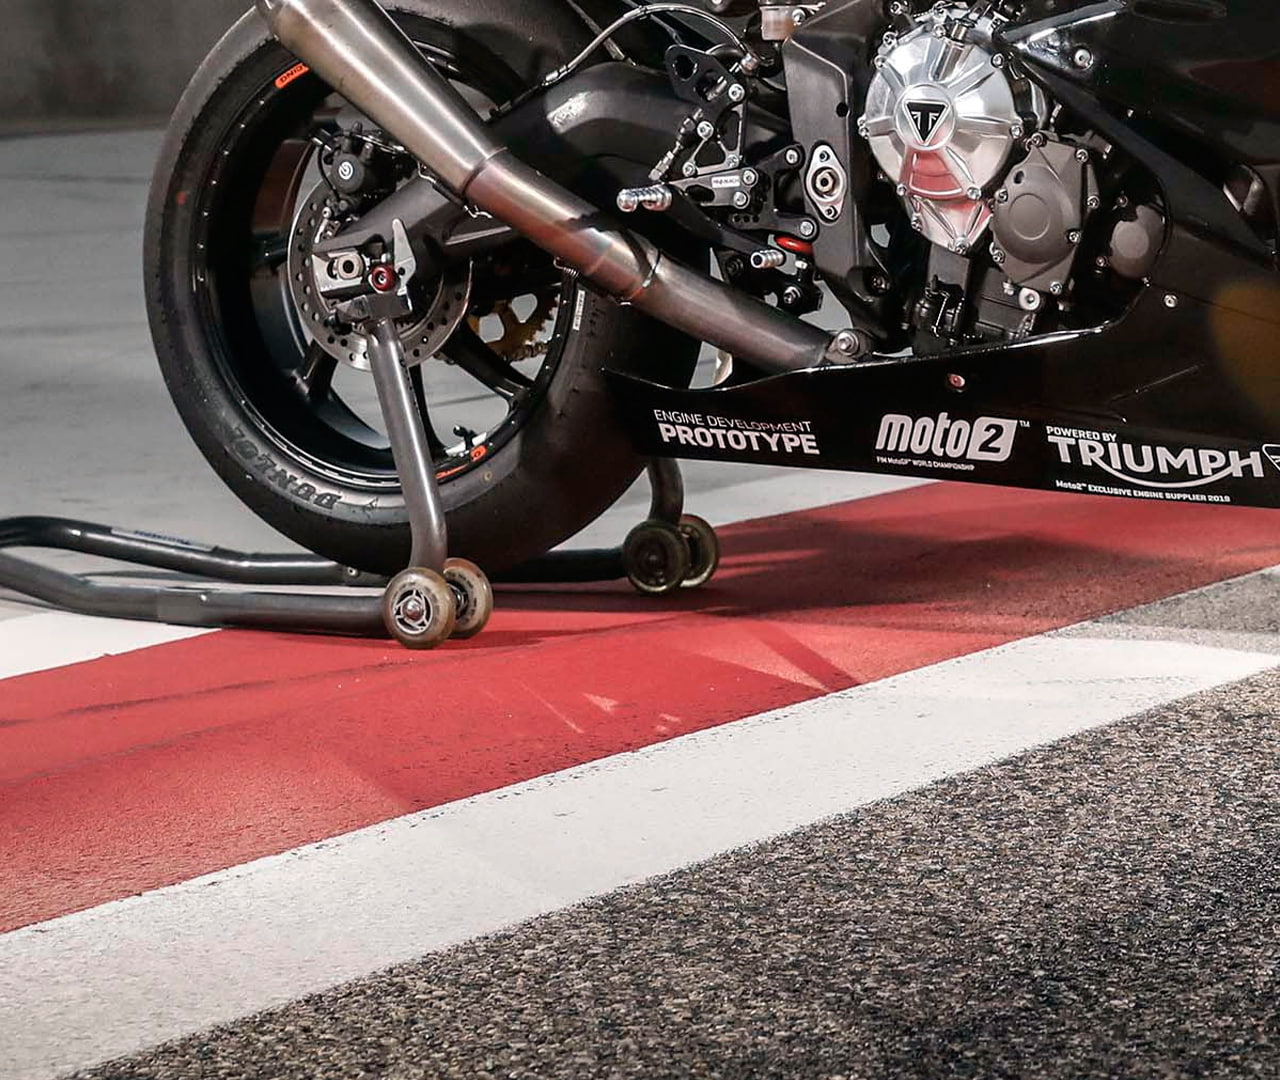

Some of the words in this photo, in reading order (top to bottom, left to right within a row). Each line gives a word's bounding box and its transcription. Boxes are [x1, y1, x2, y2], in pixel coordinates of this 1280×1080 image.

[653, 409, 705, 426] ENGINE
[706, 415, 811, 432] DEVELOPMENT
[658, 423, 820, 455] PROTOTYPE
[1045, 425, 1100, 440] POWERED
[1101, 432, 1117, 442] BY
[1047, 435, 1264, 488] TRIUMPH
[1087, 484, 1132, 497] EXCLUSIVE
[1133, 489, 1164, 499] ENGINE
[1165, 492, 1207, 501] SUPPLIER
